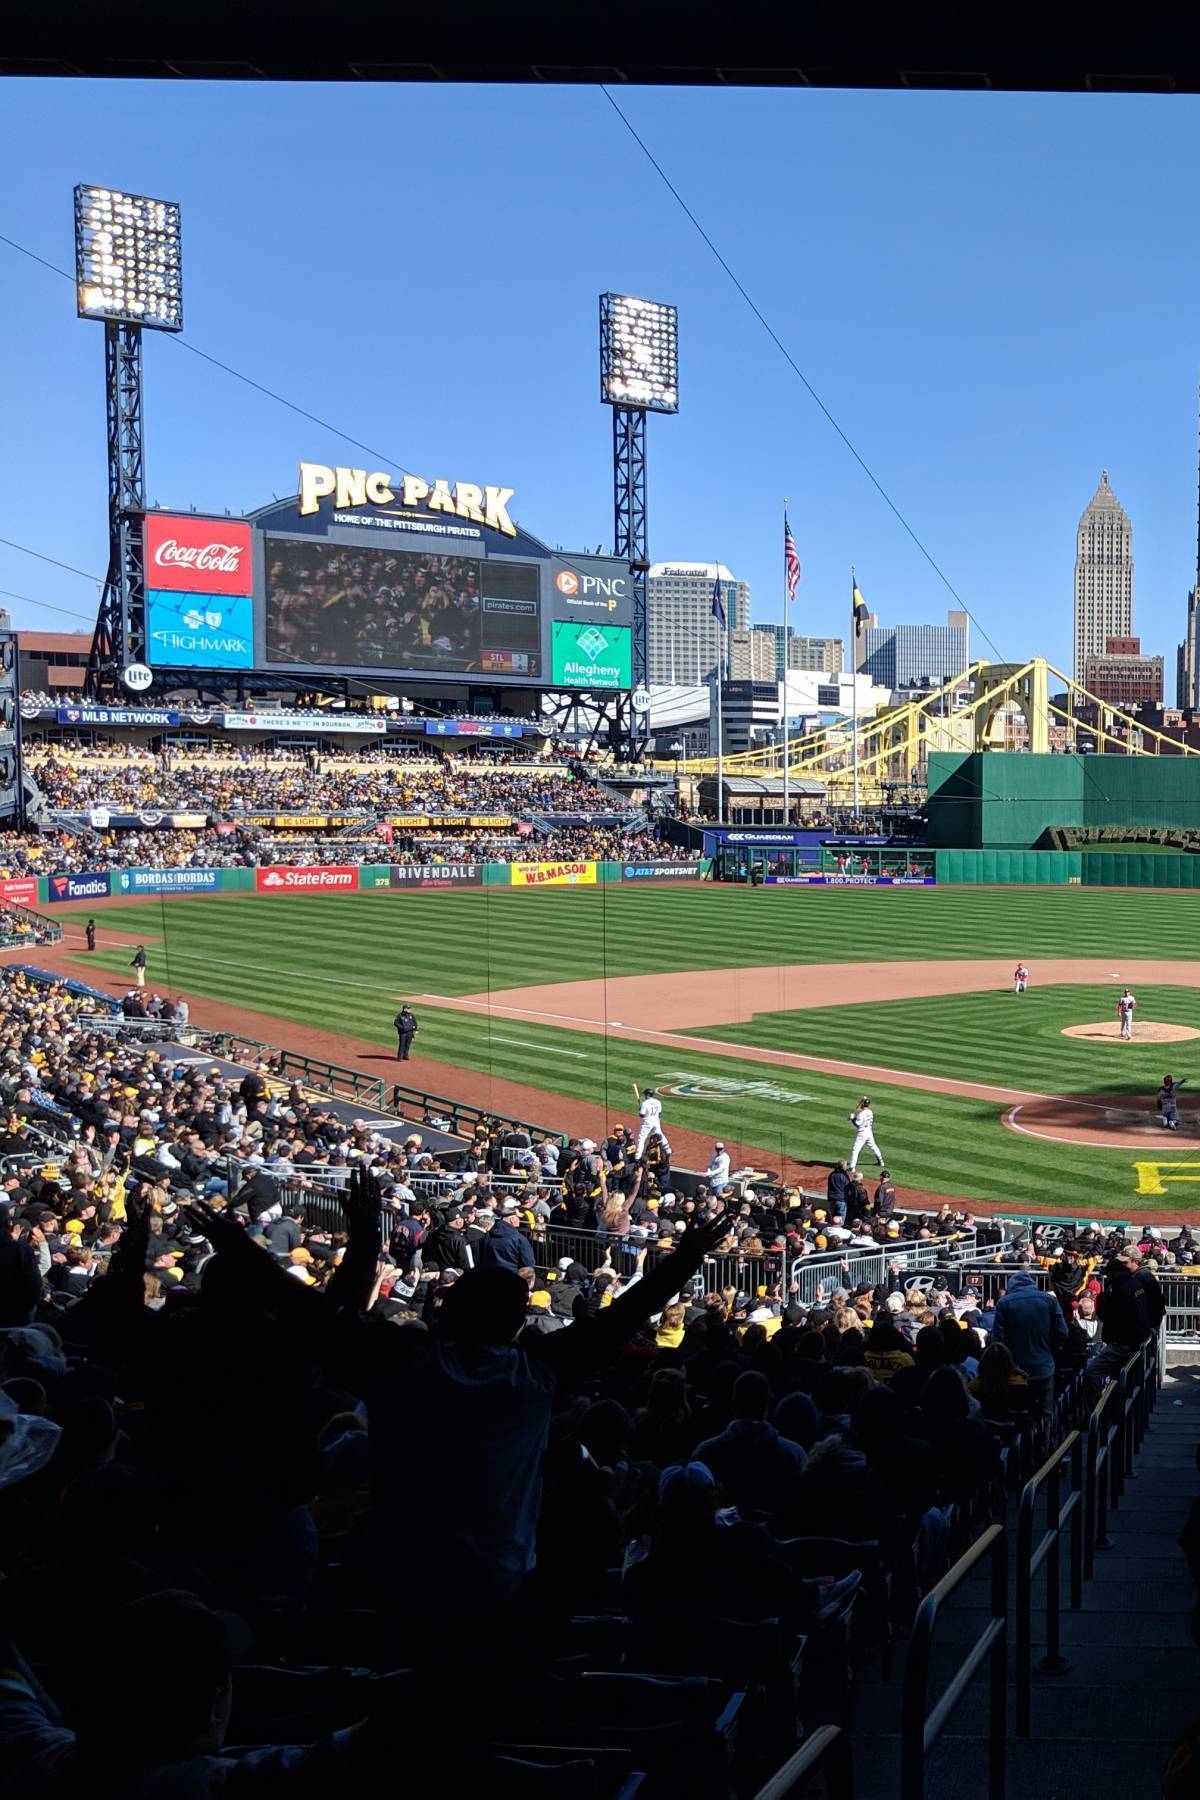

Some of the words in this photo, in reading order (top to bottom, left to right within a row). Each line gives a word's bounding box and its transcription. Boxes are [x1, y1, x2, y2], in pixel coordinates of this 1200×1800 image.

[299, 463, 396, 515] PNC
[403, 475, 517, 538] PARK
[334, 513, 361, 525] HOME
[361, 516, 373, 525] OF
[375, 518, 393, 529] THE
[393, 520, 446, 534] PITTSBURGH
[447, 525, 481, 537] PIRATES
[661, 567, 708, 577] Federated
[581, 575, 626, 597] PNC
[486, 601, 533, 613] pirates.com
[156, 631, 248, 653] HIGHMARK
[563, 662, 620, 677] Allegheny
[128, 670, 150, 684] Lite
[564, 676, 588, 687] Health
[589, 677, 619, 687] Network
[634, 694, 650, 706] Lite
[82, 711, 109, 722] MLB
[111, 712, 170, 724] NETWORK
[295, 818, 320, 826] LIGHT
[443, 818, 466, 826] LIGHT
[487, 818, 510, 826] LIGHT
[744, 833, 794, 841] GUARDIAN
[398, 866, 475, 878] RIVENDALE
[654, 867, 698, 875] SPORTSNET
[135, 873, 174, 884] BORDAS
[177, 872, 216, 884] BORDAS
[285, 871, 320, 885] State
[320, 871, 353, 884] Farm
[69, 879, 107, 896] Fanatics
